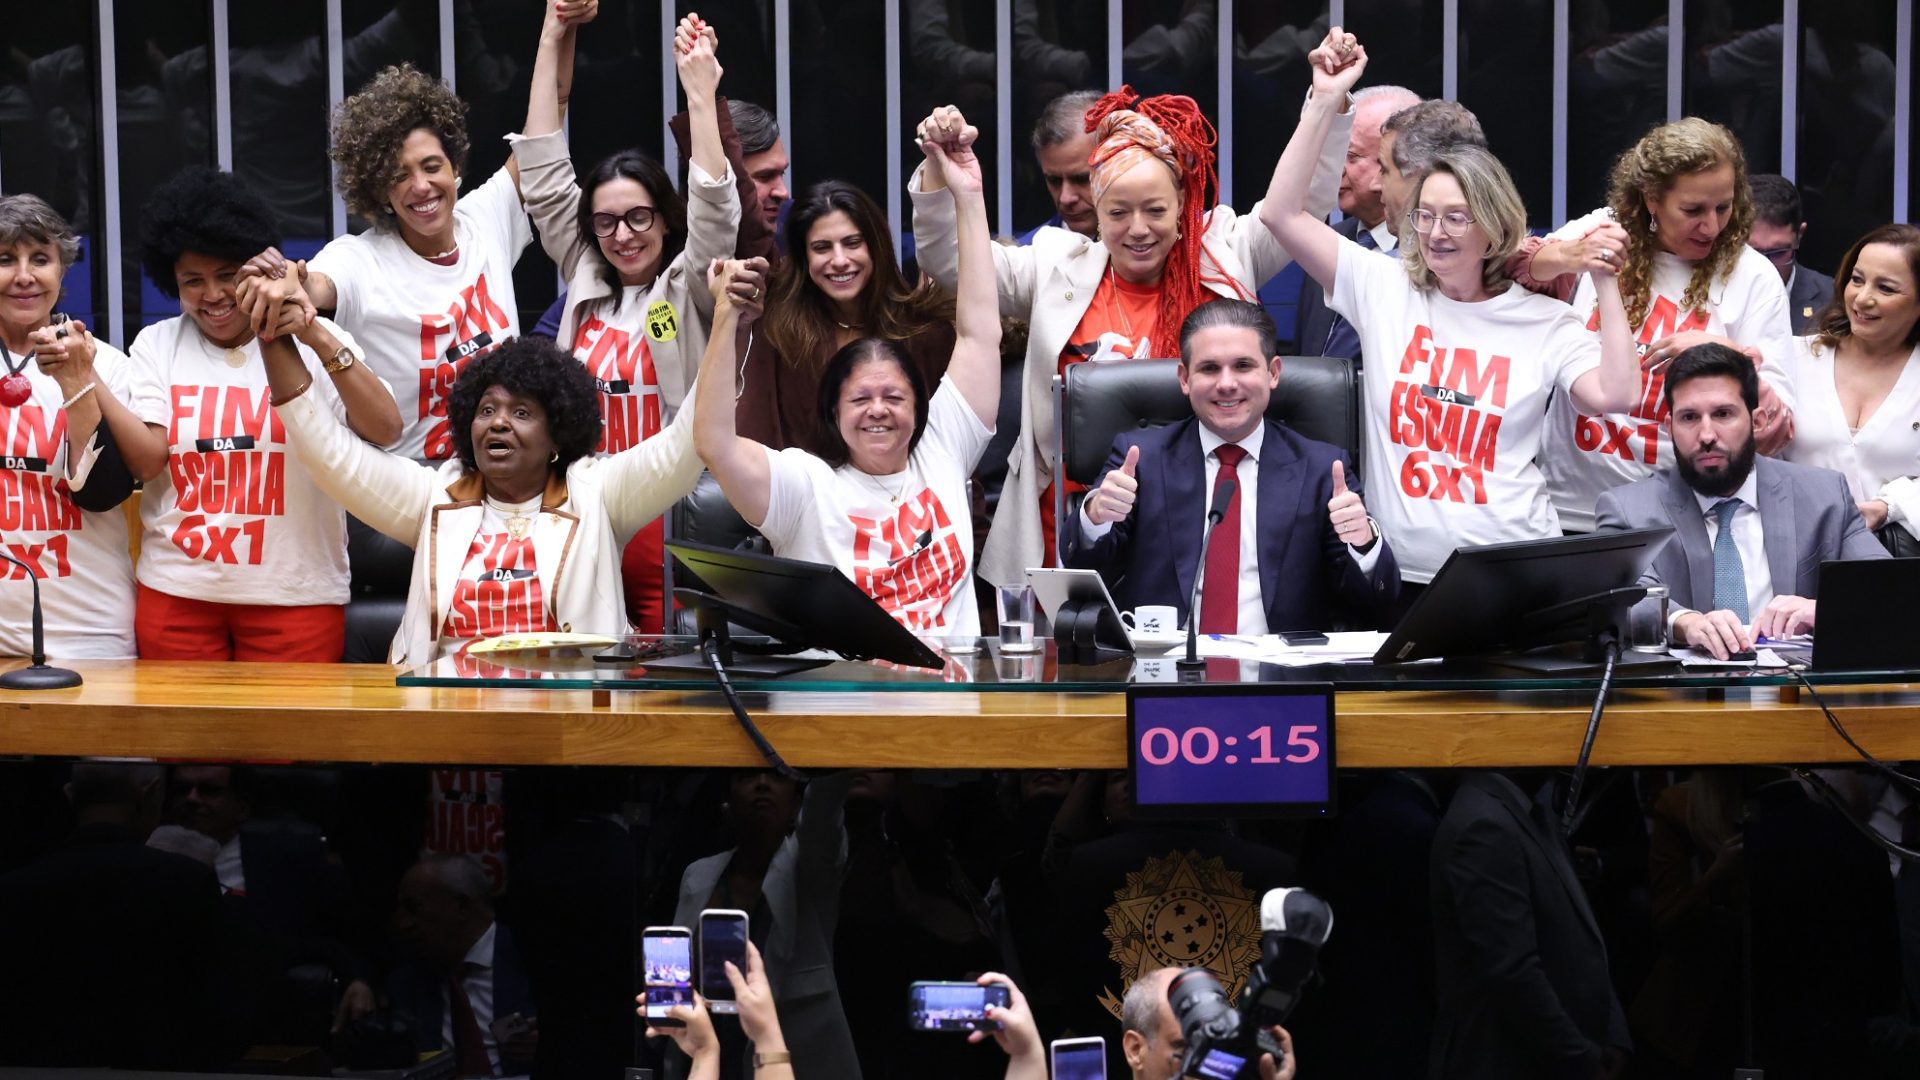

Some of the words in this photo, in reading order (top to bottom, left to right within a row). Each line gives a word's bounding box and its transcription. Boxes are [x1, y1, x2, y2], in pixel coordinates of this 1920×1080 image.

[419, 273, 509, 360] FIM
[659, 304, 669, 313] FIM
[457, 339, 480, 356] DA
[573, 312, 658, 385] FIM
[1399, 324, 1511, 409] FIM
[168, 385, 286, 448] FIM
[1437, 388, 1456, 402] DA
[0, 405, 69, 465] IM
[213, 438, 235, 451] DA
[1389, 380, 1503, 473] ESCALA
[1575, 414, 1660, 465] 6x1
[5, 457, 27, 469] DA
[169, 451, 285, 516] ESCALA
[1400, 451, 1488, 505] 6x1
[172, 515, 265, 565] 6x1
[493, 569, 514, 581] DA
[1140, 726, 1320, 766] 00:15
